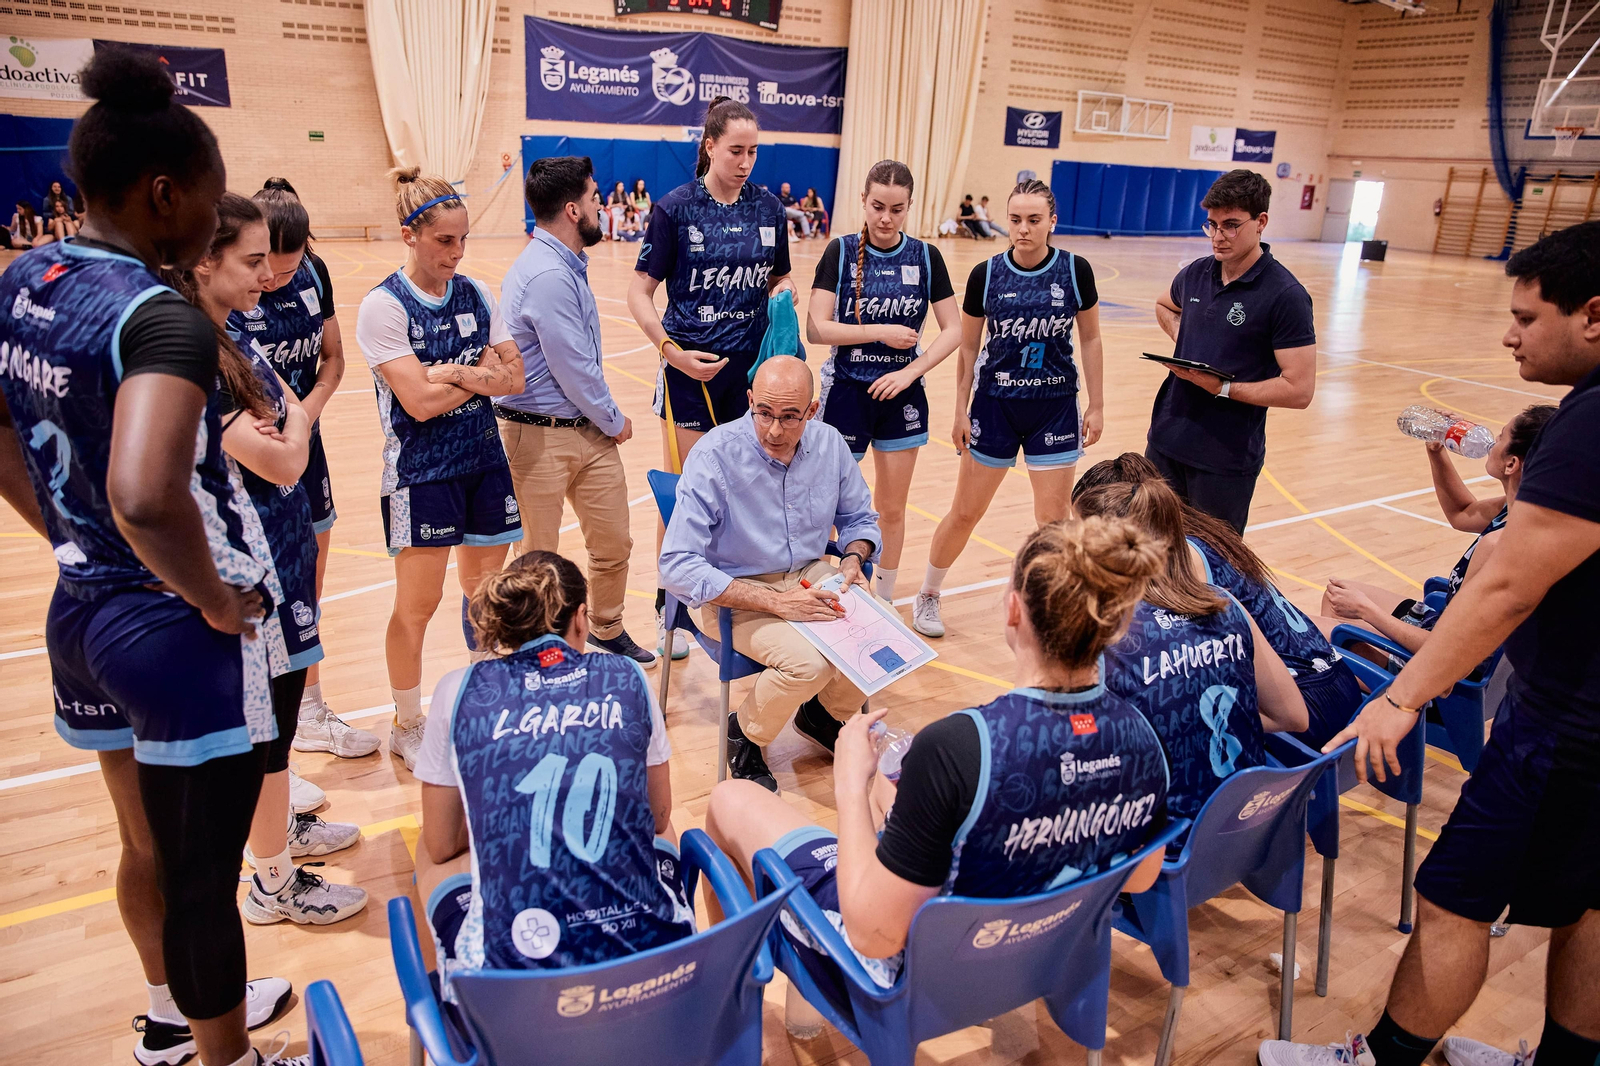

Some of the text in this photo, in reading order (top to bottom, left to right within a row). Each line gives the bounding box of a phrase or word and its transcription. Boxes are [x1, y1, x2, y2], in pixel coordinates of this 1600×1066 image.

[175, 72, 209, 88] FIT
[569, 61, 640, 86] Leganés
[570, 82, 640, 97] AYUNTAMIENTO
[689, 261, 774, 294] LEGANÉS
[845, 294, 923, 321] LEGANÉS
[993, 313, 1073, 343] LEGANÉS
[850, 348, 912, 363] innova-tsn
[995, 371, 1066, 387] innova-tsn
[432, 526, 456, 536] Leganés
[1143, 633, 1247, 686] LAHUERTA
[541, 667, 588, 685] Leganés
[492, 693, 624, 741] L.GARCÍA
[1199, 685, 1243, 779] 8
[1076, 753, 1121, 774] Leganés
[514, 752, 618, 869] 10
[1003, 793, 1156, 862] HERNANGÓMEZ
[566, 904, 622, 924] HOSPITAL
[1008, 899, 1083, 937] Leganés
[598, 961, 697, 1004] Leganés
